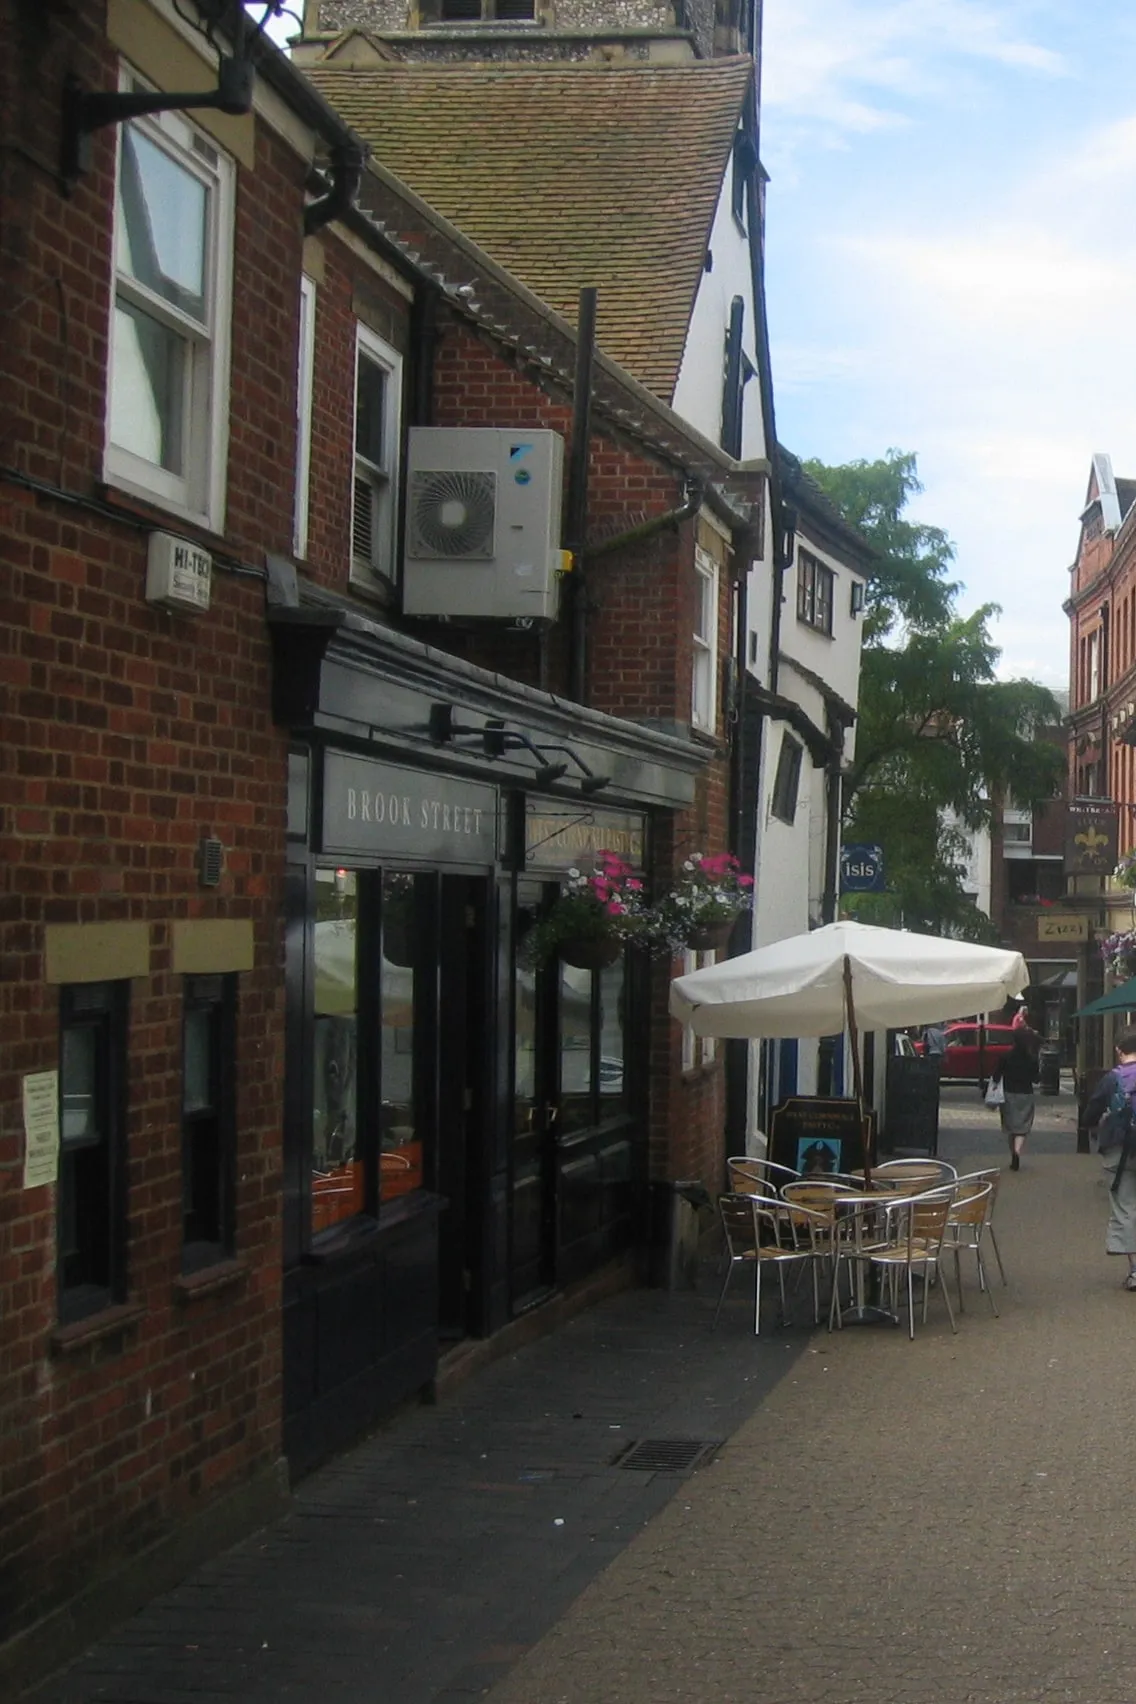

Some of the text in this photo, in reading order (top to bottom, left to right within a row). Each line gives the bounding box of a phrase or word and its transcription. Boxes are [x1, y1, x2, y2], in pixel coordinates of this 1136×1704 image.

[347, 788, 482, 834] BROOK STREET
[845, 862, 874, 876] isis
